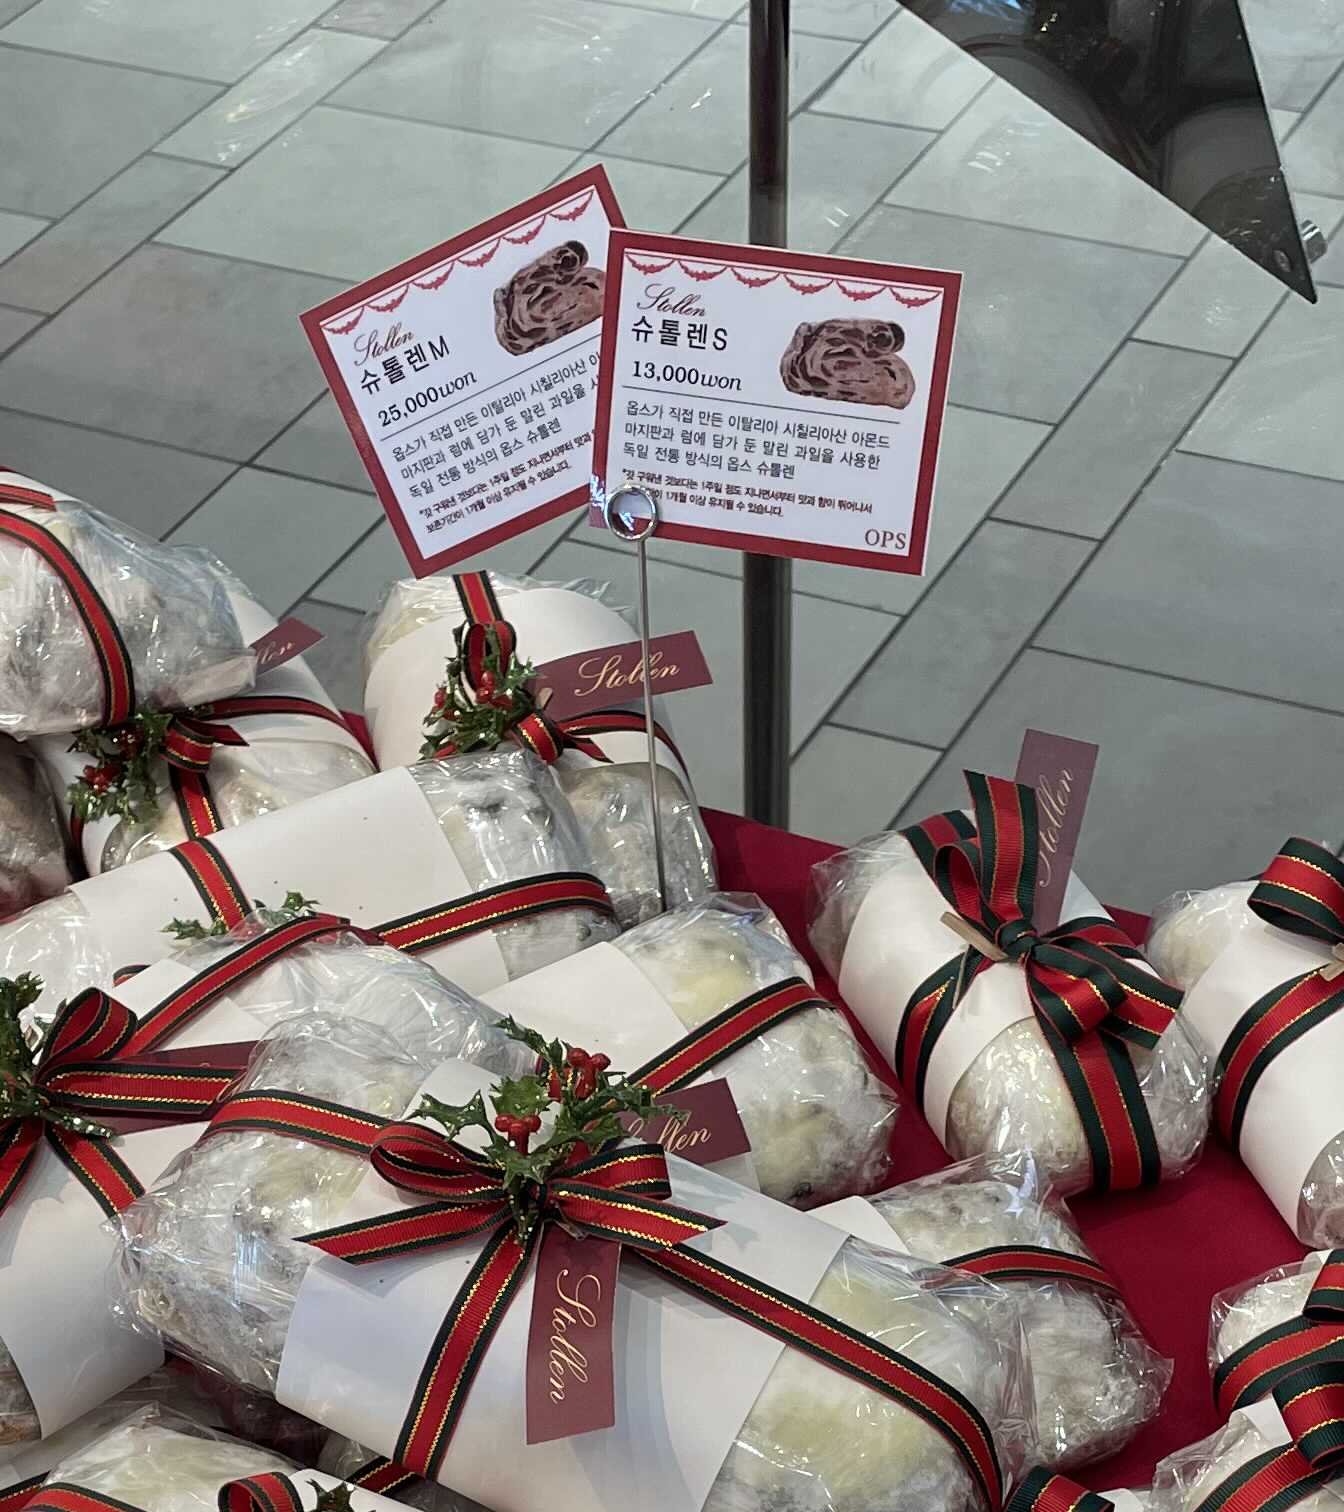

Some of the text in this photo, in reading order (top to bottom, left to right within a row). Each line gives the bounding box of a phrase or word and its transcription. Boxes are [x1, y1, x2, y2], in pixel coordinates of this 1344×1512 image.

[636, 283, 705, 317] Stollen
[353, 322, 414, 367] Stollen
[632, 316, 727, 351] 슈톨렌S
[361, 335, 450, 395] 슈톨렌M
[633, 360, 741, 391] 13,000won
[378, 372, 477, 427] 25,000won
[392, 435, 427, 463] 옵스가
[428, 423, 454, 442] 직접
[453, 411, 479, 433] 만든
[480, 387, 527, 418] 이탈리아
[530, 358, 587, 396] 시칠리아산
[400, 450, 447, 479] 마지판과
[447, 436, 475, 458] 럼에
[475, 423, 502, 446] 담가
[503, 415, 518, 433] 둔
[519, 402, 547, 425] 말린
[548, 383, 586, 410] 과일을
[624, 422, 881, 470] 마지판과 럼에 담가 둔 말린 과일을 사용한
[627, 400, 664, 420] 옵스가
[668, 406, 694, 424] 직접
[698, 410, 724, 428] 만든
[783, 423, 847, 445] 시칠리아산
[851, 431, 890, 449] 아몬드
[409, 417, 562, 498] 독일 전통 방식의 옵스 슈톨렌
[527, 475, 537, 486] 수
[623, 441, 795, 480] 독일 전통 방식의 옵스 슈톨렌
[735, 500, 746, 512] 수
[864, 528, 907, 550] OPS
[549, 1269, 602, 1405] Stollen
